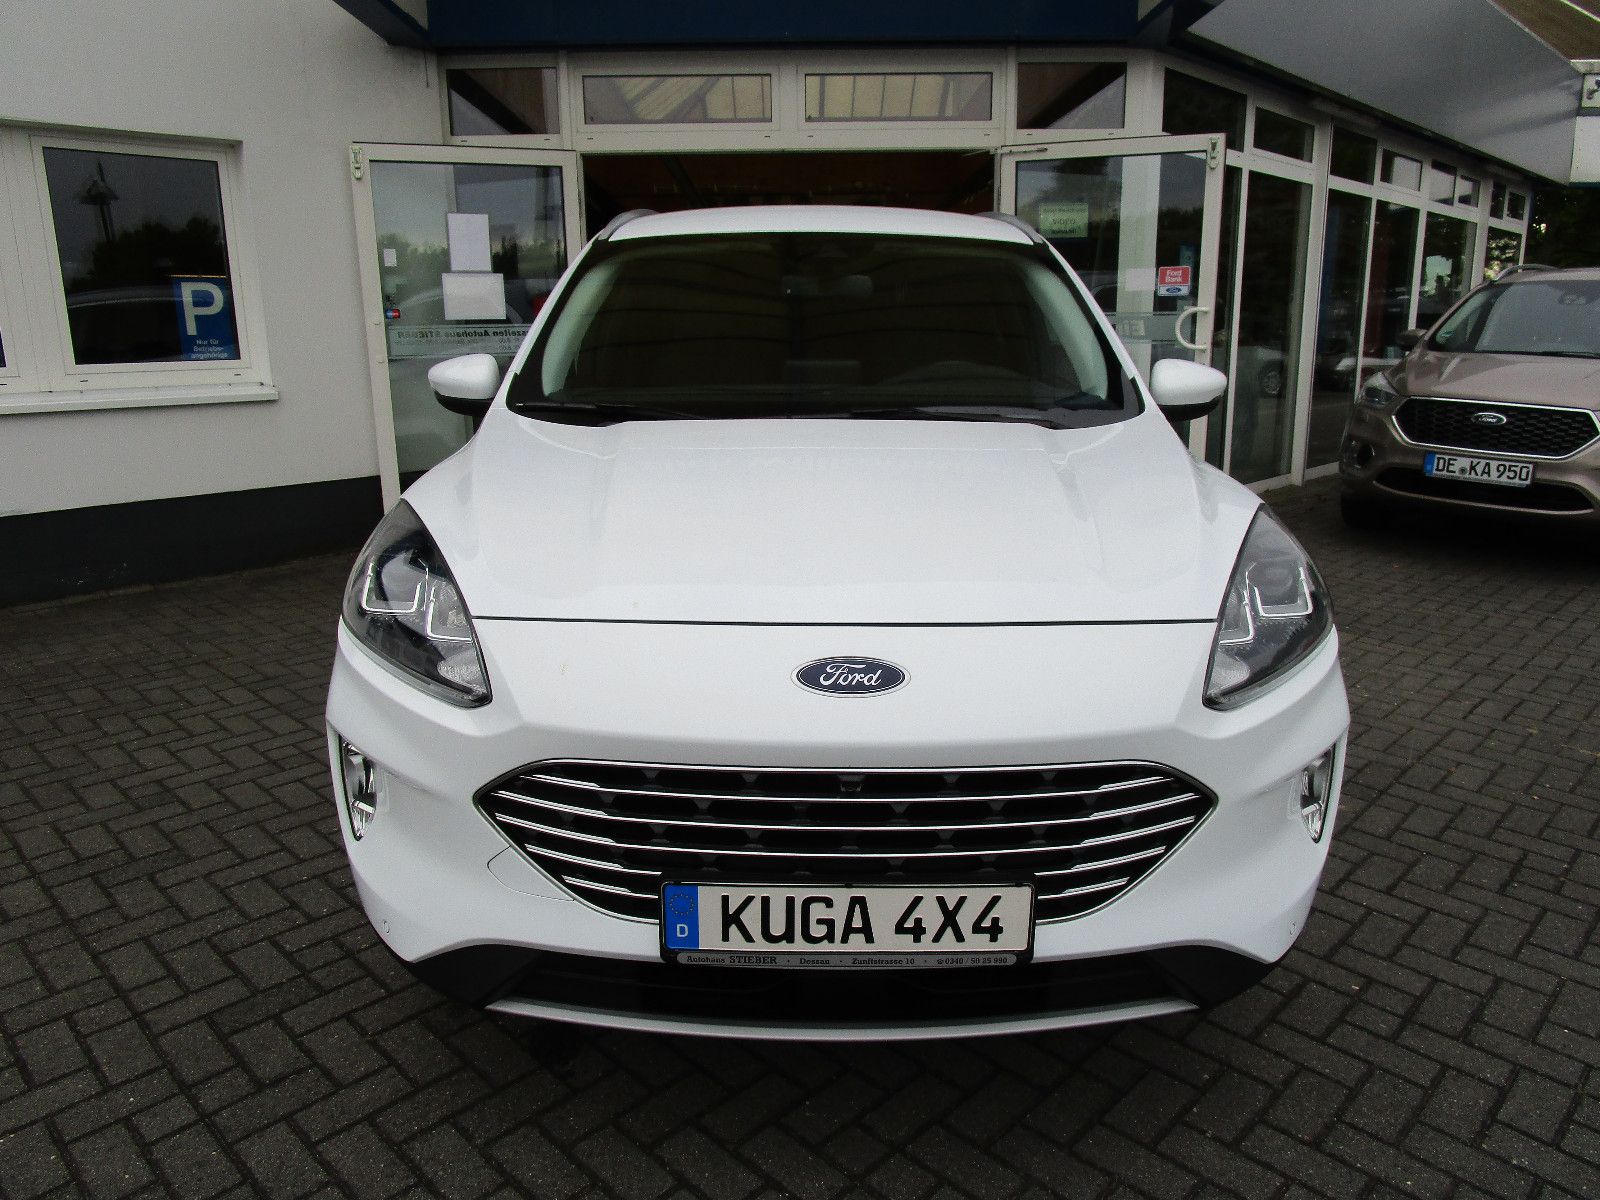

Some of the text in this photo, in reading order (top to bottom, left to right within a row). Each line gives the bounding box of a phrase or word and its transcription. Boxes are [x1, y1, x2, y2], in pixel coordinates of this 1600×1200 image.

[1166, 269, 1183, 277] Ford
[180, 281, 224, 336] P
[1434, 456, 1458, 474] DE
[1468, 461, 1492, 478] KA
[1496, 464, 1531, 482] 950
[819, 662, 883, 686] Ford
[720, 893, 1004, 944] KUGA 4X4
[675, 924, 689, 938] D
[686, 955, 726, 964] Autohaus
[729, 955, 778, 965] STIEBER
[799, 957, 830, 965] Dessau
[851, 957, 903, 966] Zunftstrasse
[905, 957, 915, 965] 10
